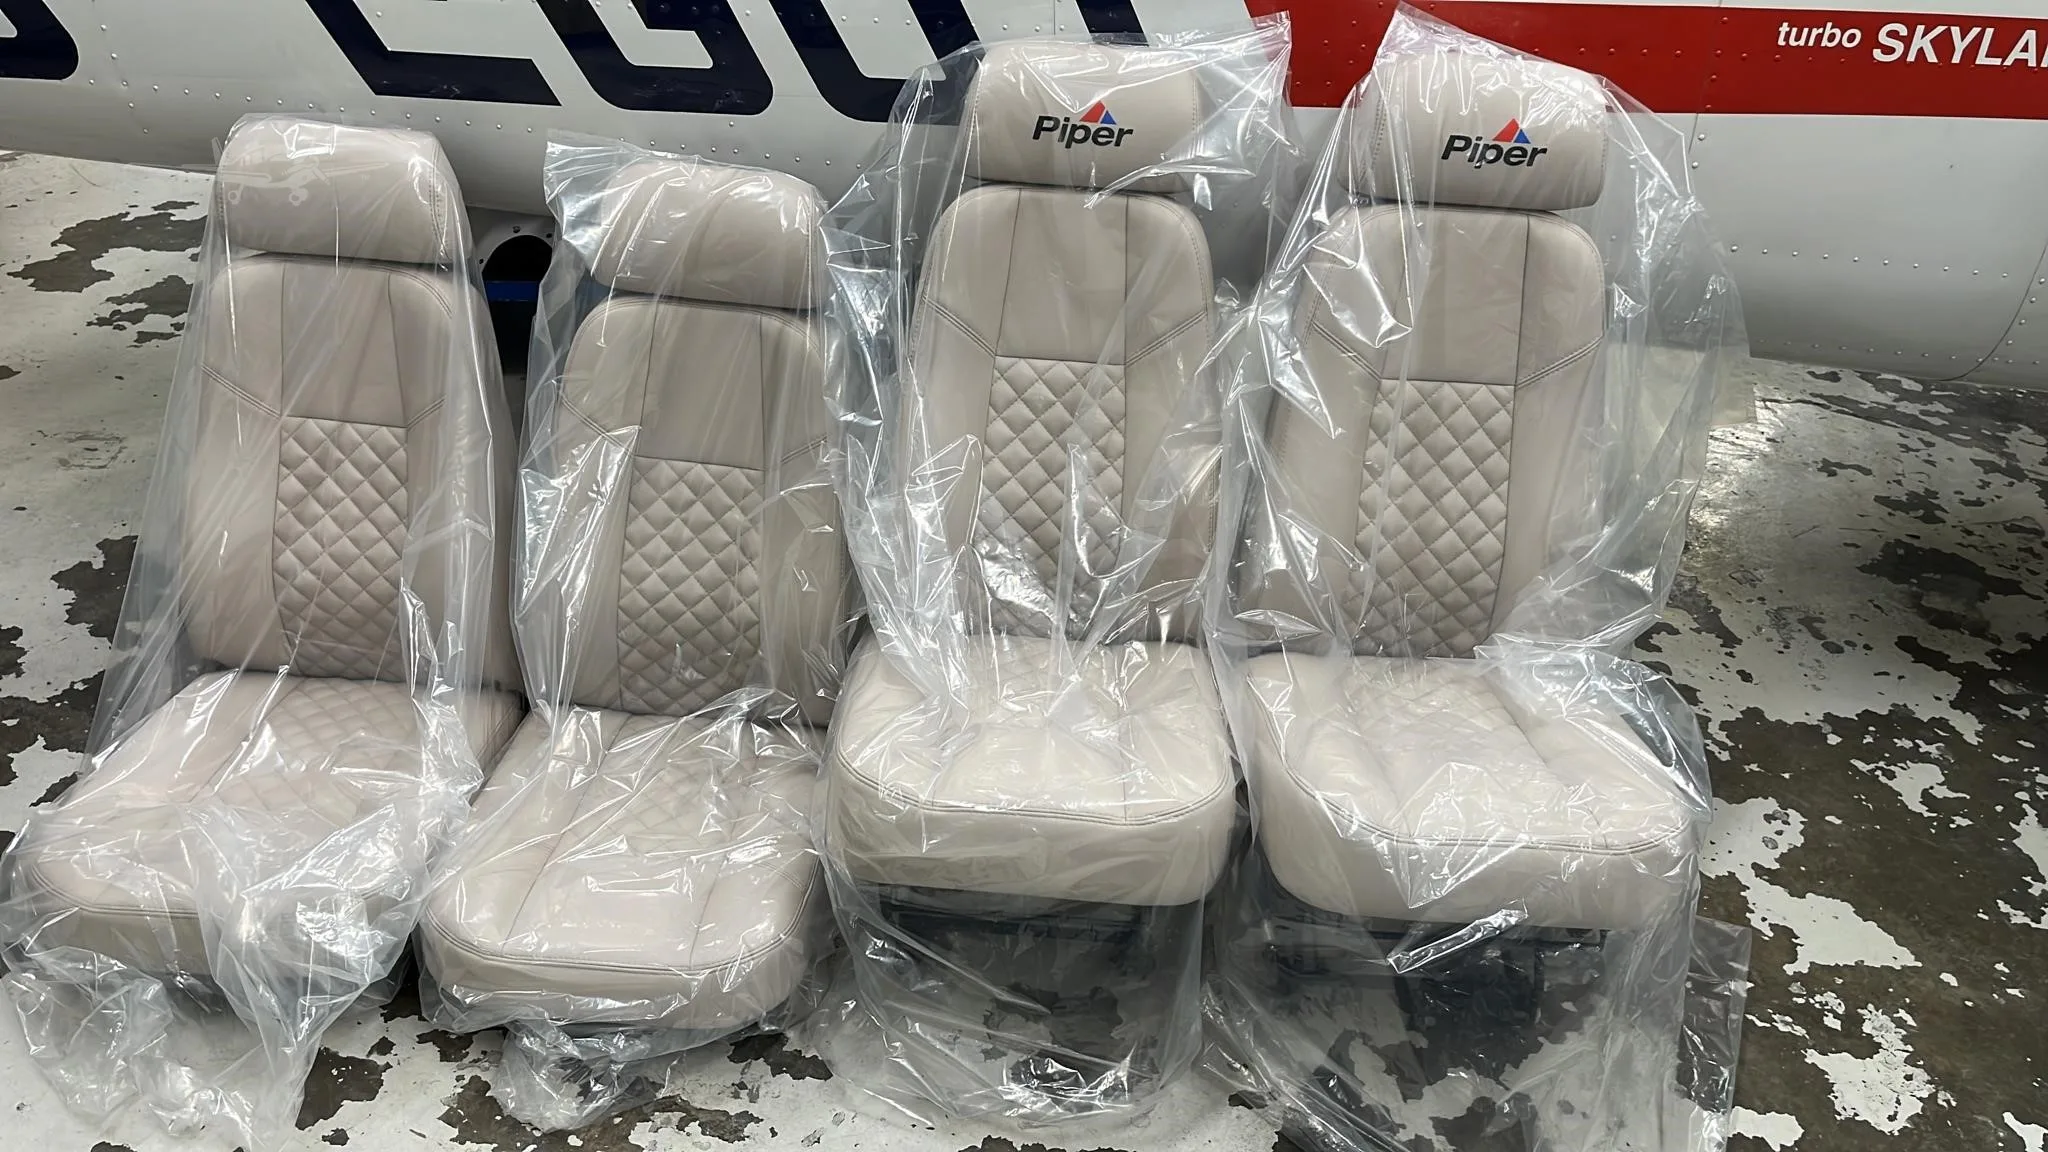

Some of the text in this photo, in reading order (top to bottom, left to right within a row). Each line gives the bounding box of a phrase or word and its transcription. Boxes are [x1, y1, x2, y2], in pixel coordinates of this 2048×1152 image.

[1776, 21, 2048, 68] turbo SKYLA
[1032, 115, 1134, 149] Piper
[1441, 134, 1547, 169] Piper
